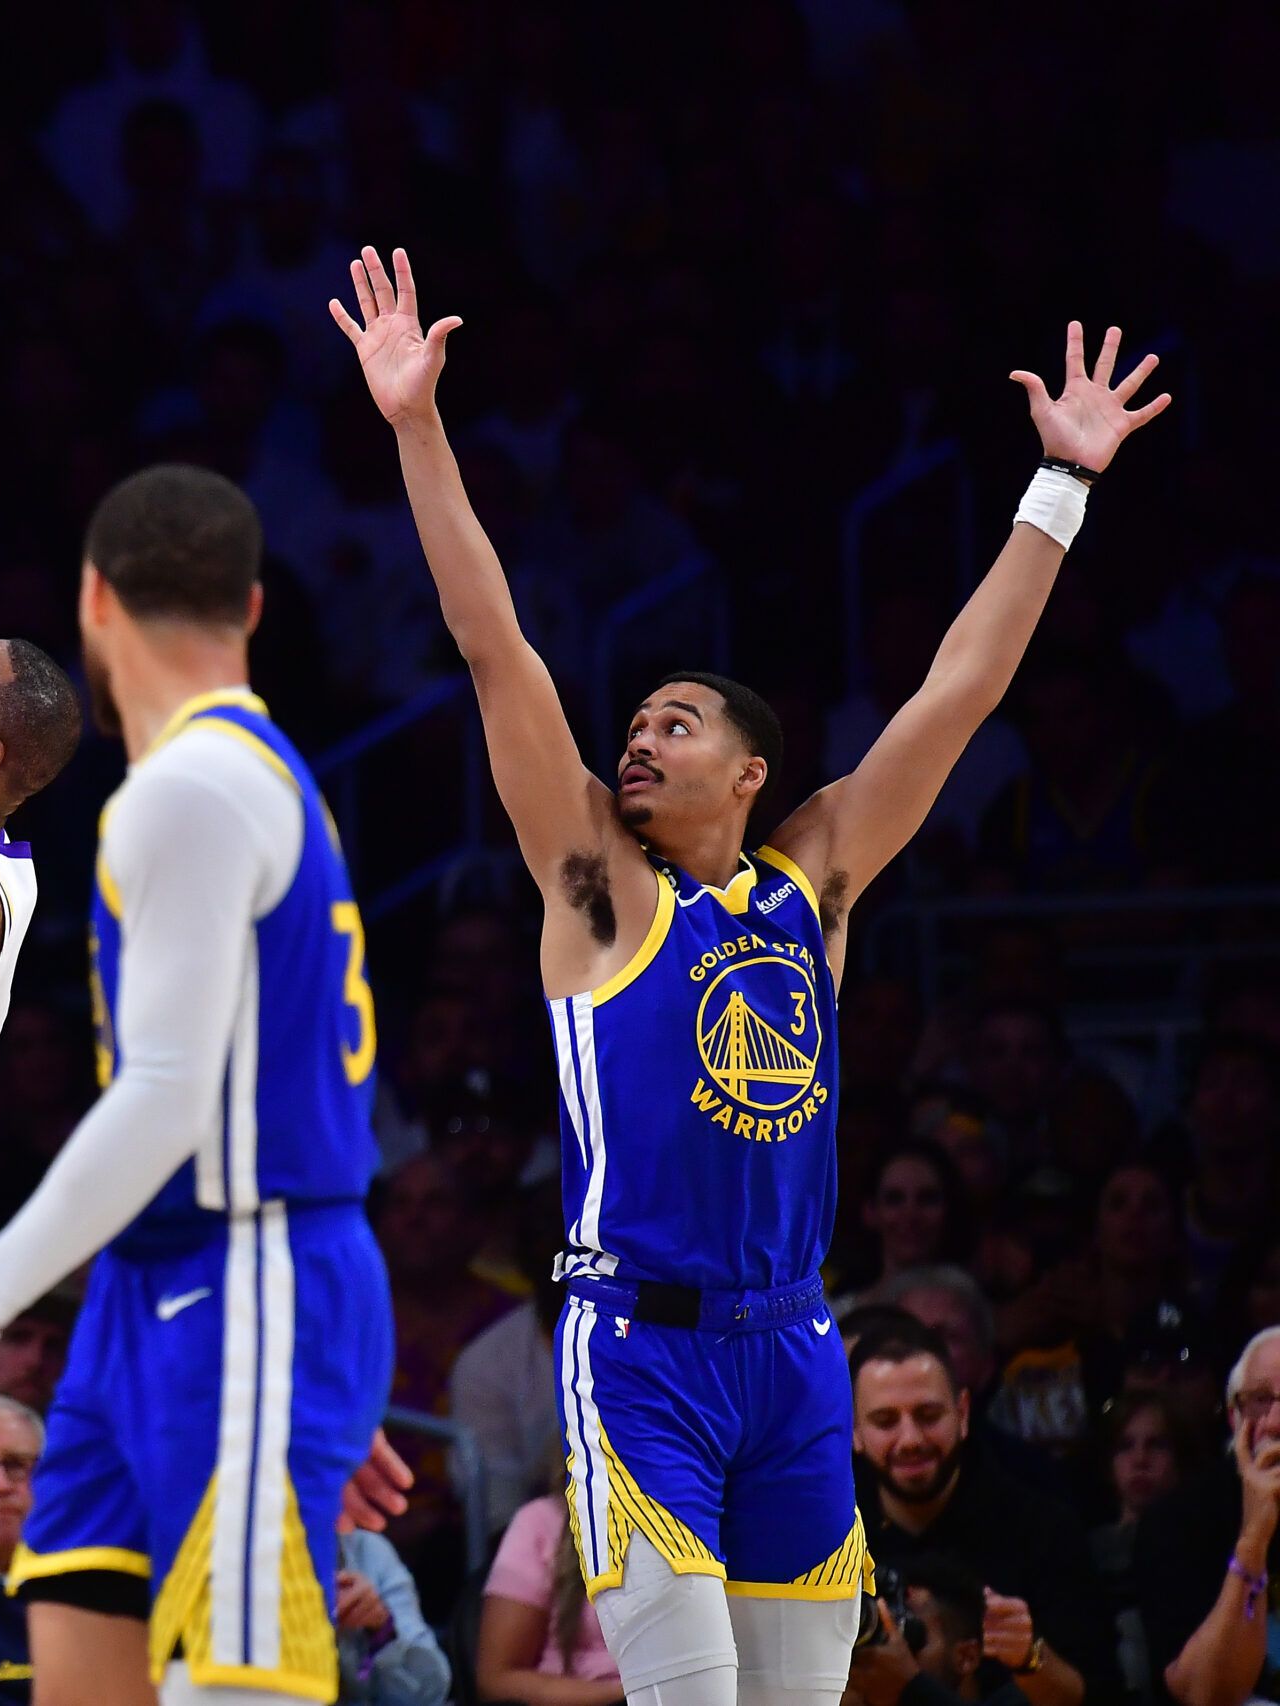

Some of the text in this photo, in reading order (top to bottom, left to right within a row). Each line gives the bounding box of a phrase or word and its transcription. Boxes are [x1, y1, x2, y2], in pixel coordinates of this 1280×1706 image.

[755, 882, 797, 914] kuten
[689, 934, 767, 982] GOLDEN
[789, 991, 807, 1036] 3
[690, 1077, 828, 1142] WARRIORS
